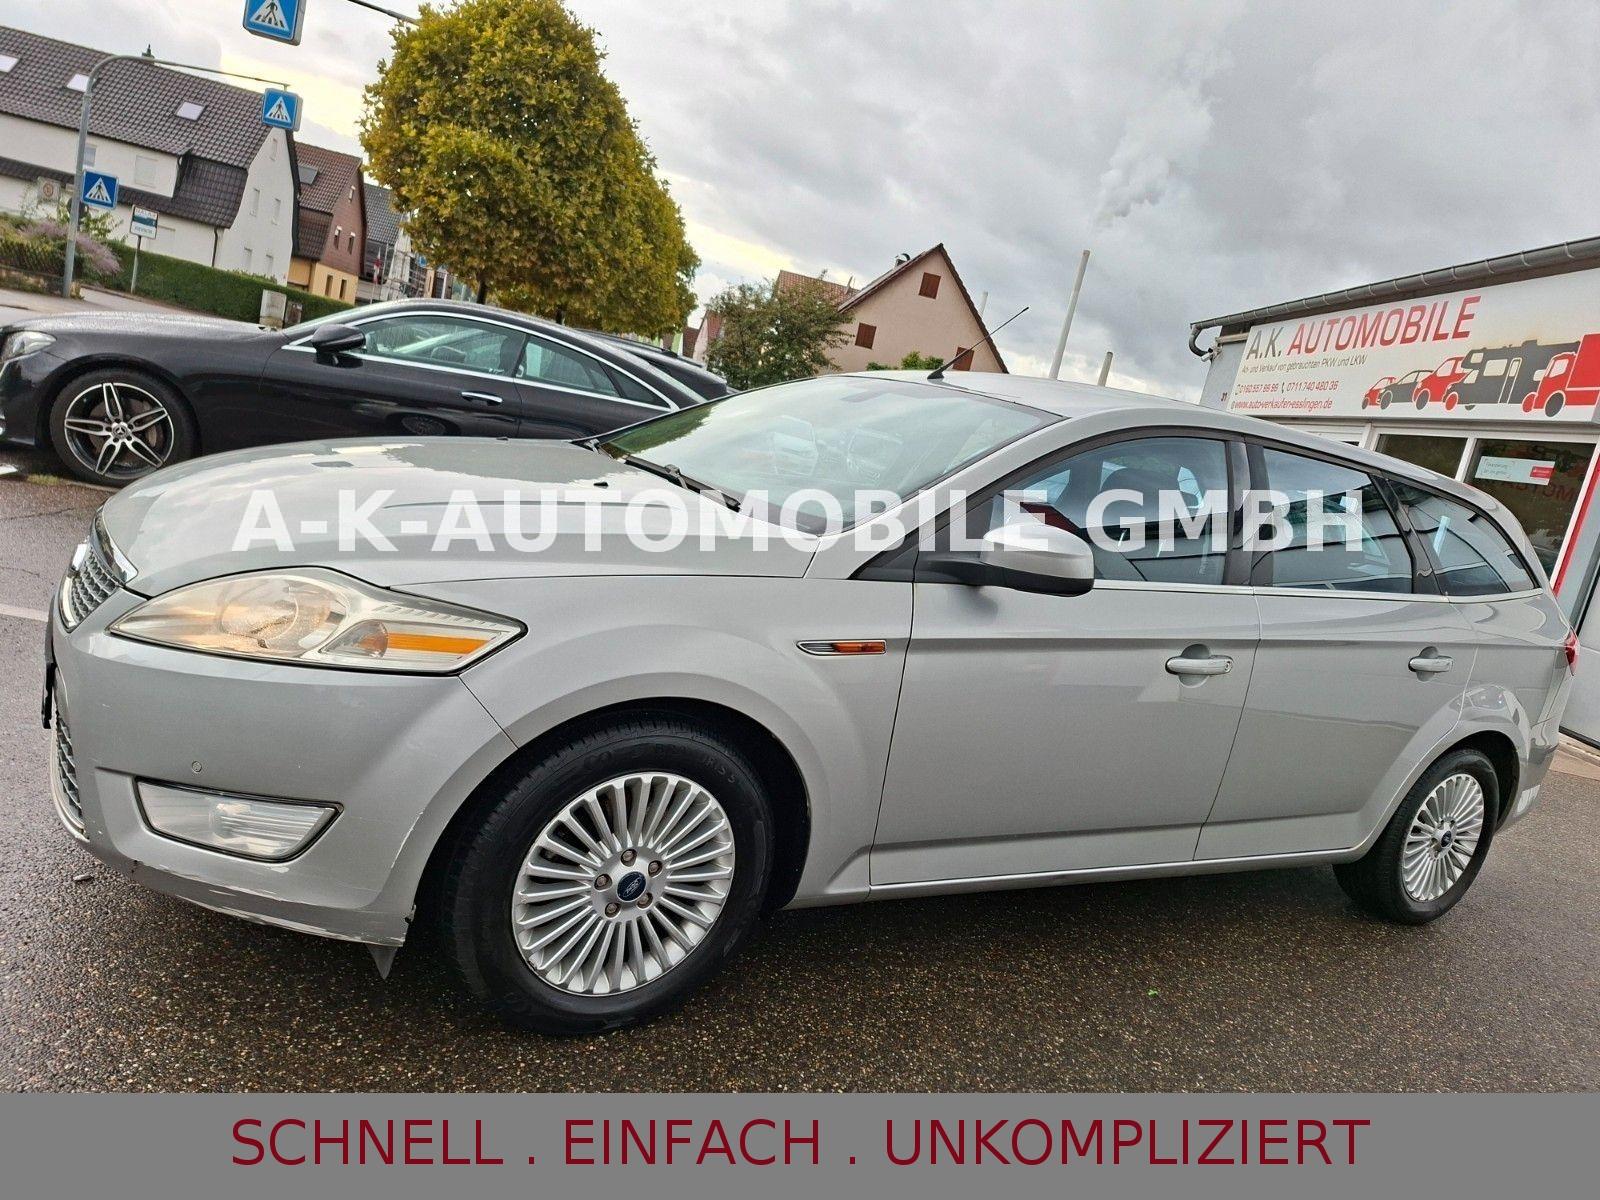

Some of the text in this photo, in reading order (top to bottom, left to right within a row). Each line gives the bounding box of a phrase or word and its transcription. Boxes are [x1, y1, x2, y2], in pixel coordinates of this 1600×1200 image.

[1246, 295, 1482, 360] A.K. AUTOMOBILE
[1286, 360, 1321, 373] gebrauchten
[1321, 358, 1337, 367] PKW
[1336, 357, 1349, 367] und
[1350, 354, 1368, 366] LKW
